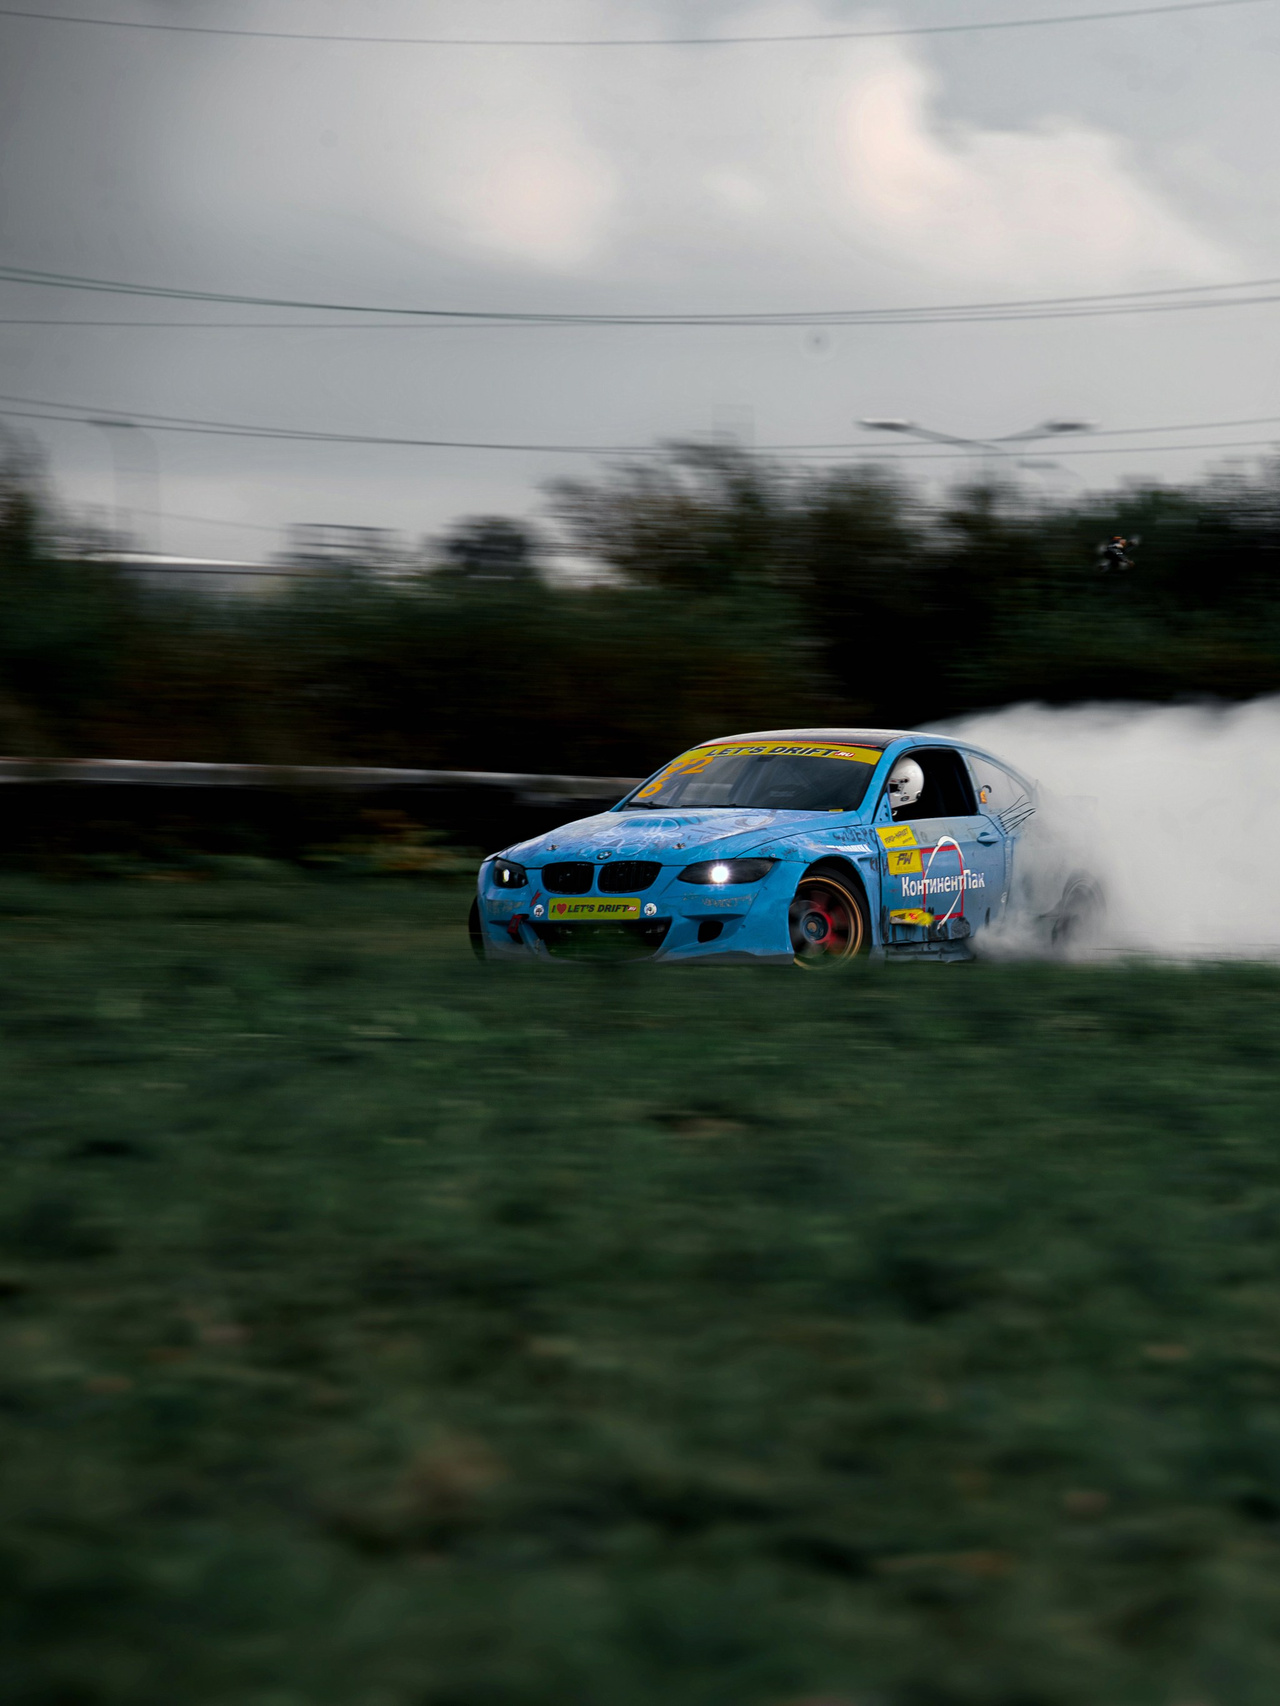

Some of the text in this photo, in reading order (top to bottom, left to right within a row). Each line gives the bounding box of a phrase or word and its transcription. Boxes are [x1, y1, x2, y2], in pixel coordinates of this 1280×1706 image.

[705, 746, 766, 757] LET'S
[901, 869, 985, 897] КонтинентПак
[567, 904, 595, 913] LET'S
